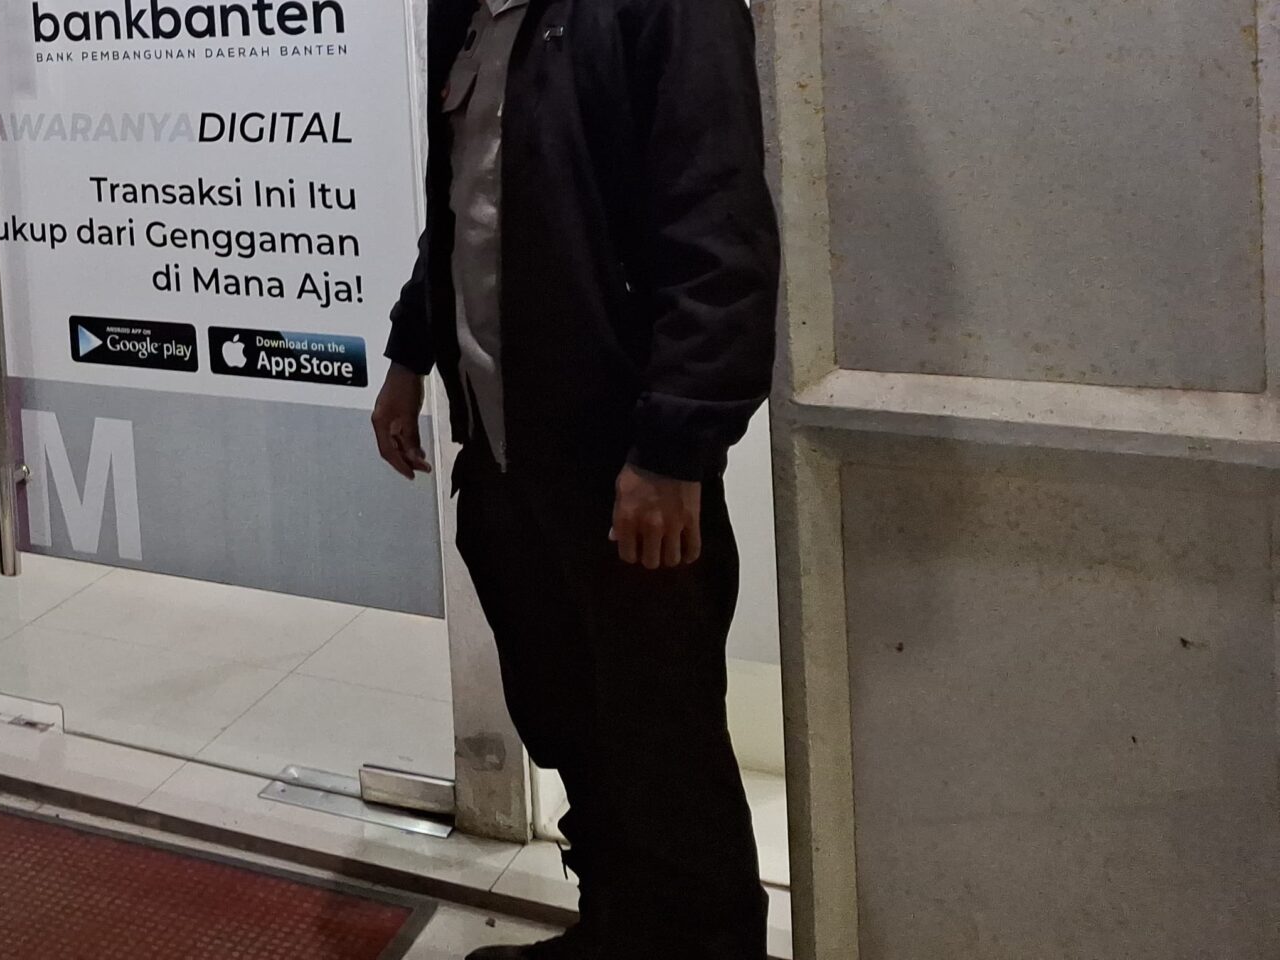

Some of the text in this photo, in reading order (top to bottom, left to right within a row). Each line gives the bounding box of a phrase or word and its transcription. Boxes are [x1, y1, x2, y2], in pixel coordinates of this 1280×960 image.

[36, 44, 348, 63] BANK PEMBANGUNAN DAERAH BANTEN
[198, 112, 353, 144] DIGITAL
[89, 176, 356, 210] Transaksi Ini Itu
[76, 218, 135, 246] dari
[145, 222, 360, 259] Genggaman
[152, 264, 364, 308] di Mana Aja!
[106, 326, 131, 334] ANDROID
[131, 327, 142, 335] APP
[255, 336, 346, 353] Download on the
[106, 334, 192, 360] Google play
[257, 350, 354, 378] App Store
